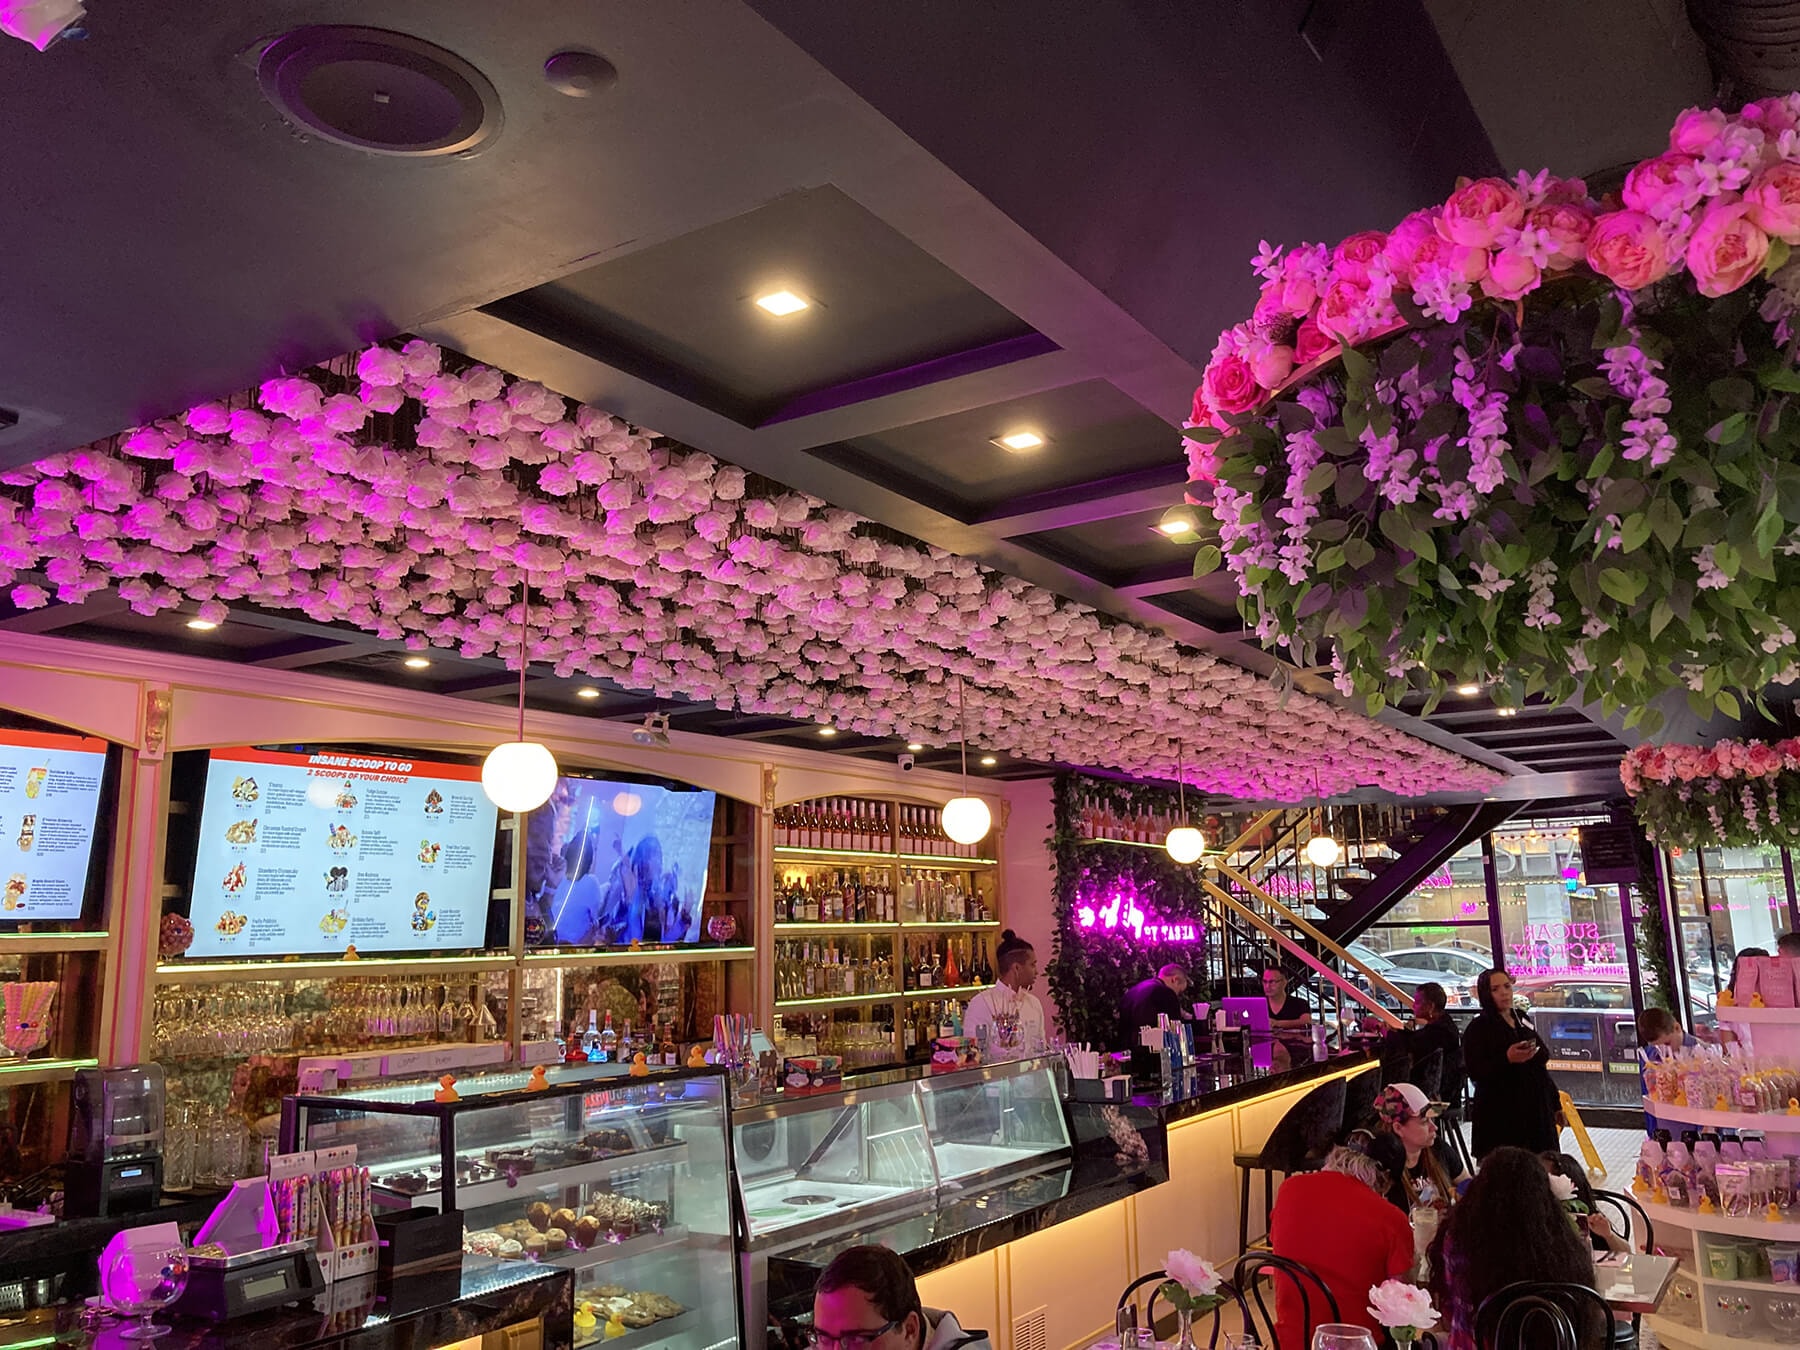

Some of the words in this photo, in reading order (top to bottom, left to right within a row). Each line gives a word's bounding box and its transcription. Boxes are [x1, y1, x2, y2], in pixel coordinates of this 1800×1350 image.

[308, 755, 349, 767] INSANE
[349, 758, 384, 770] SCOOP
[384, 761, 398, 771] TO
[398, 762, 413, 772] GO
[314, 769, 347, 779] SCOOPS
[348, 772, 359, 780] OF
[360, 774, 381, 782] YOUR
[380, 775, 409, 784] CHOICE
[1571, 1063, 1600, 1071] SQUARE
